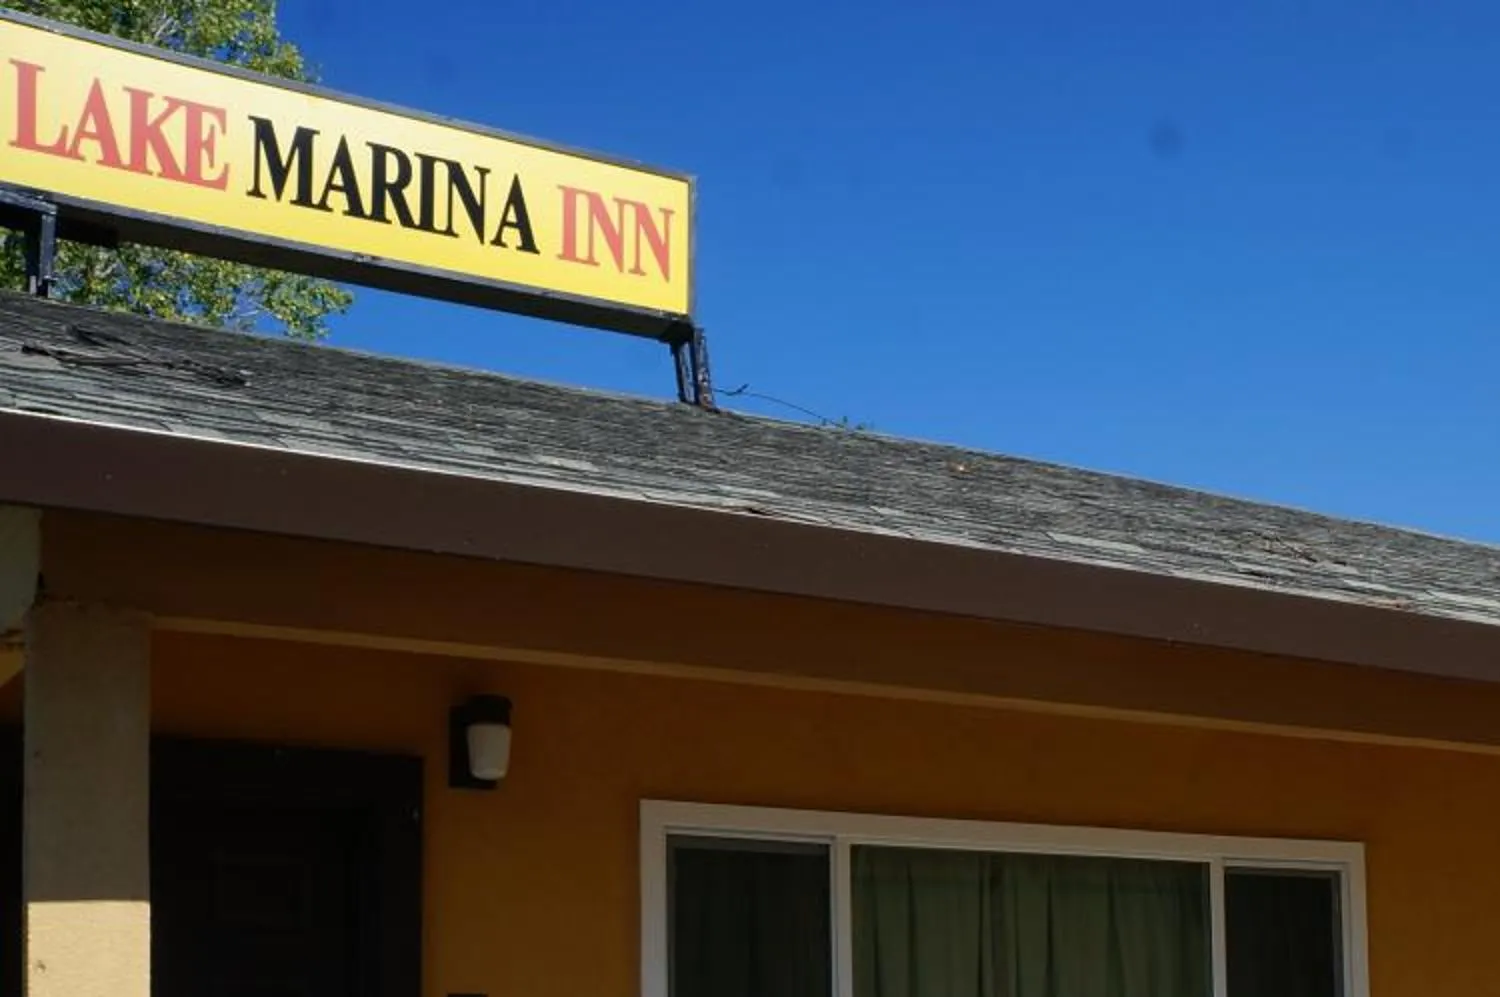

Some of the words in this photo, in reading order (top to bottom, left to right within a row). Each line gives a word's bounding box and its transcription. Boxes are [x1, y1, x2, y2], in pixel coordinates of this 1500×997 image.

[9, 59, 231, 190] LAKE
[247, 115, 540, 255] MARINA
[556, 185, 674, 283] INN
